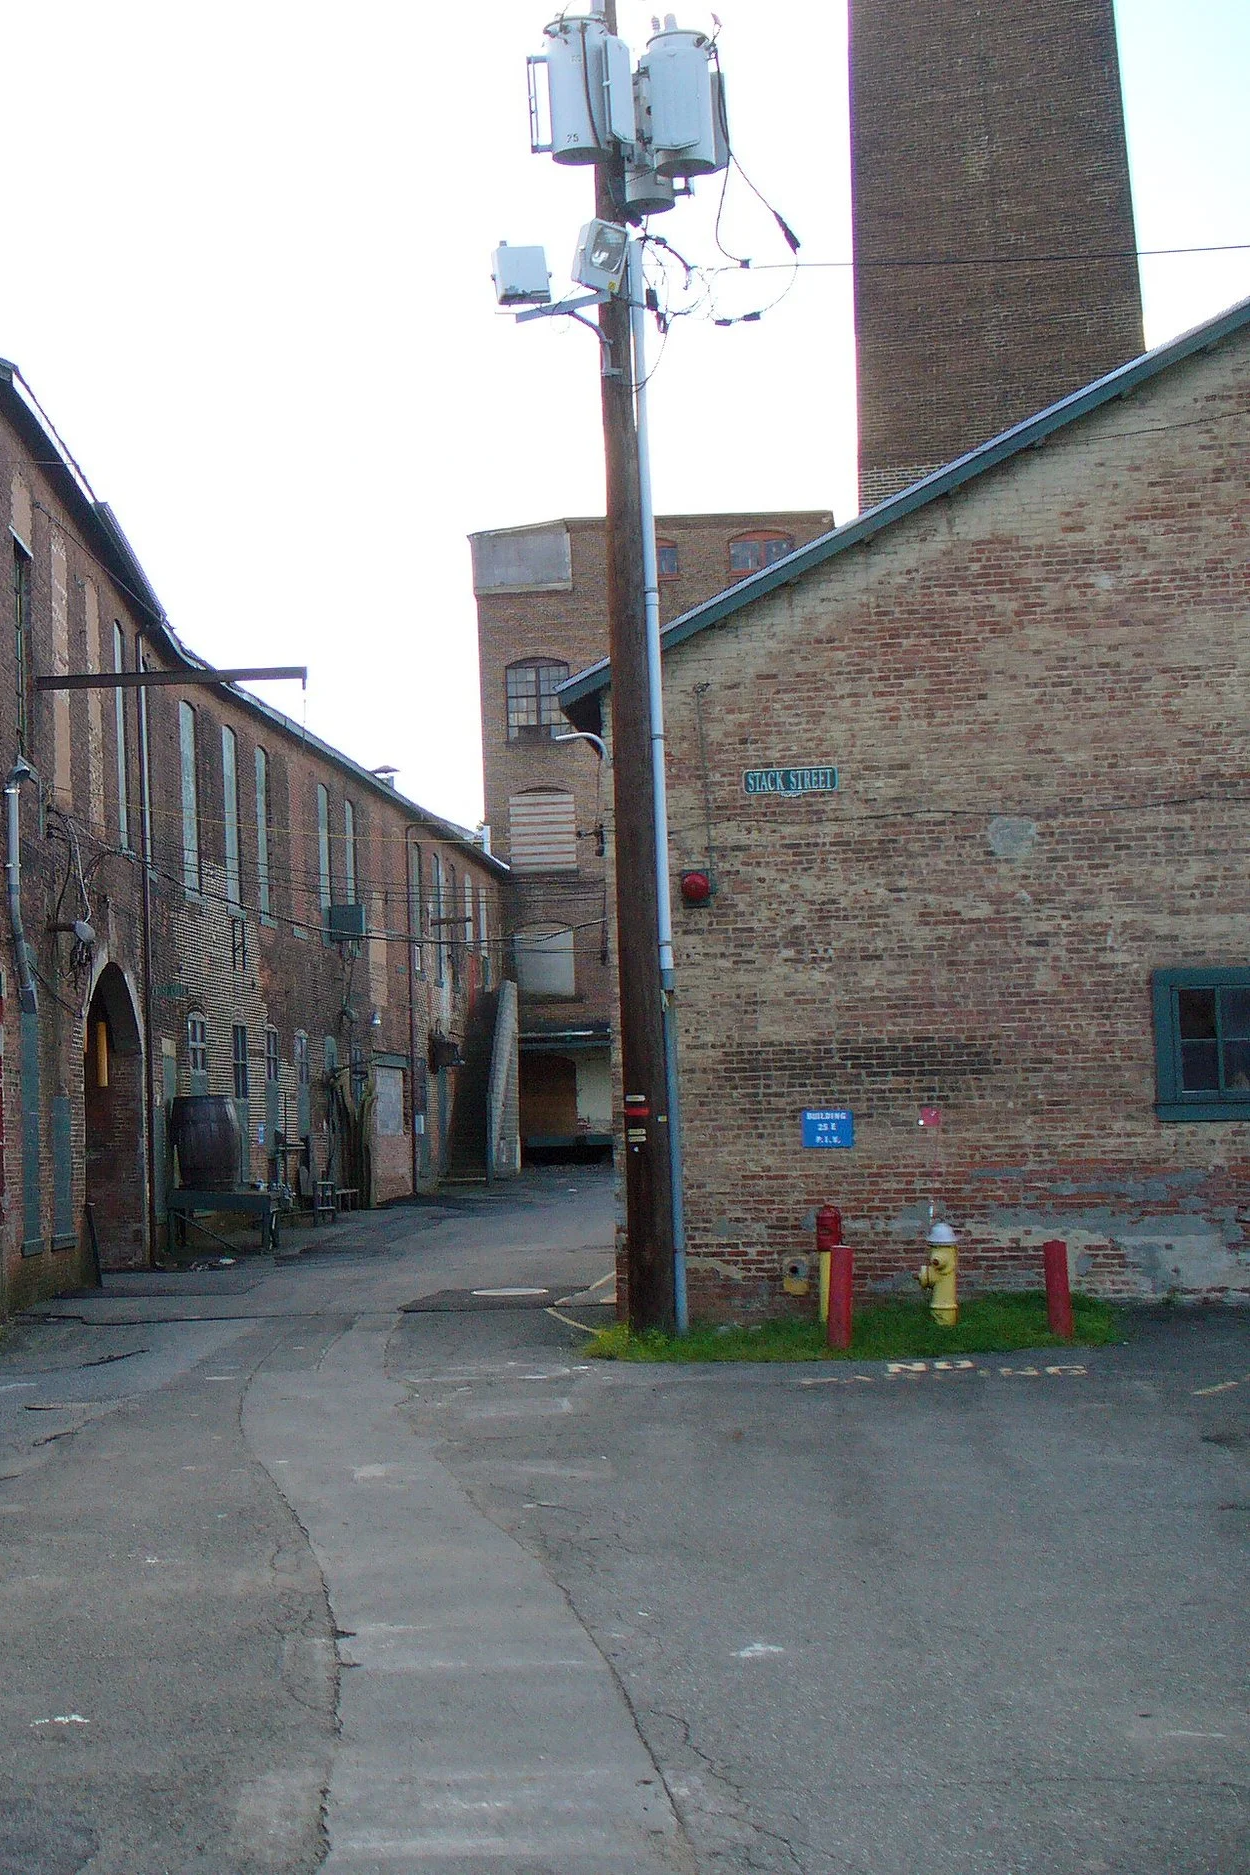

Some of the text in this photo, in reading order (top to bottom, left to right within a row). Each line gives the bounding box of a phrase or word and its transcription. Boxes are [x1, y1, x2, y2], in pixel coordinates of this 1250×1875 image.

[747, 769, 832, 791] STACK STREET
[806, 1112, 847, 1120] BUILDING
[886, 1360, 974, 1373] NO
